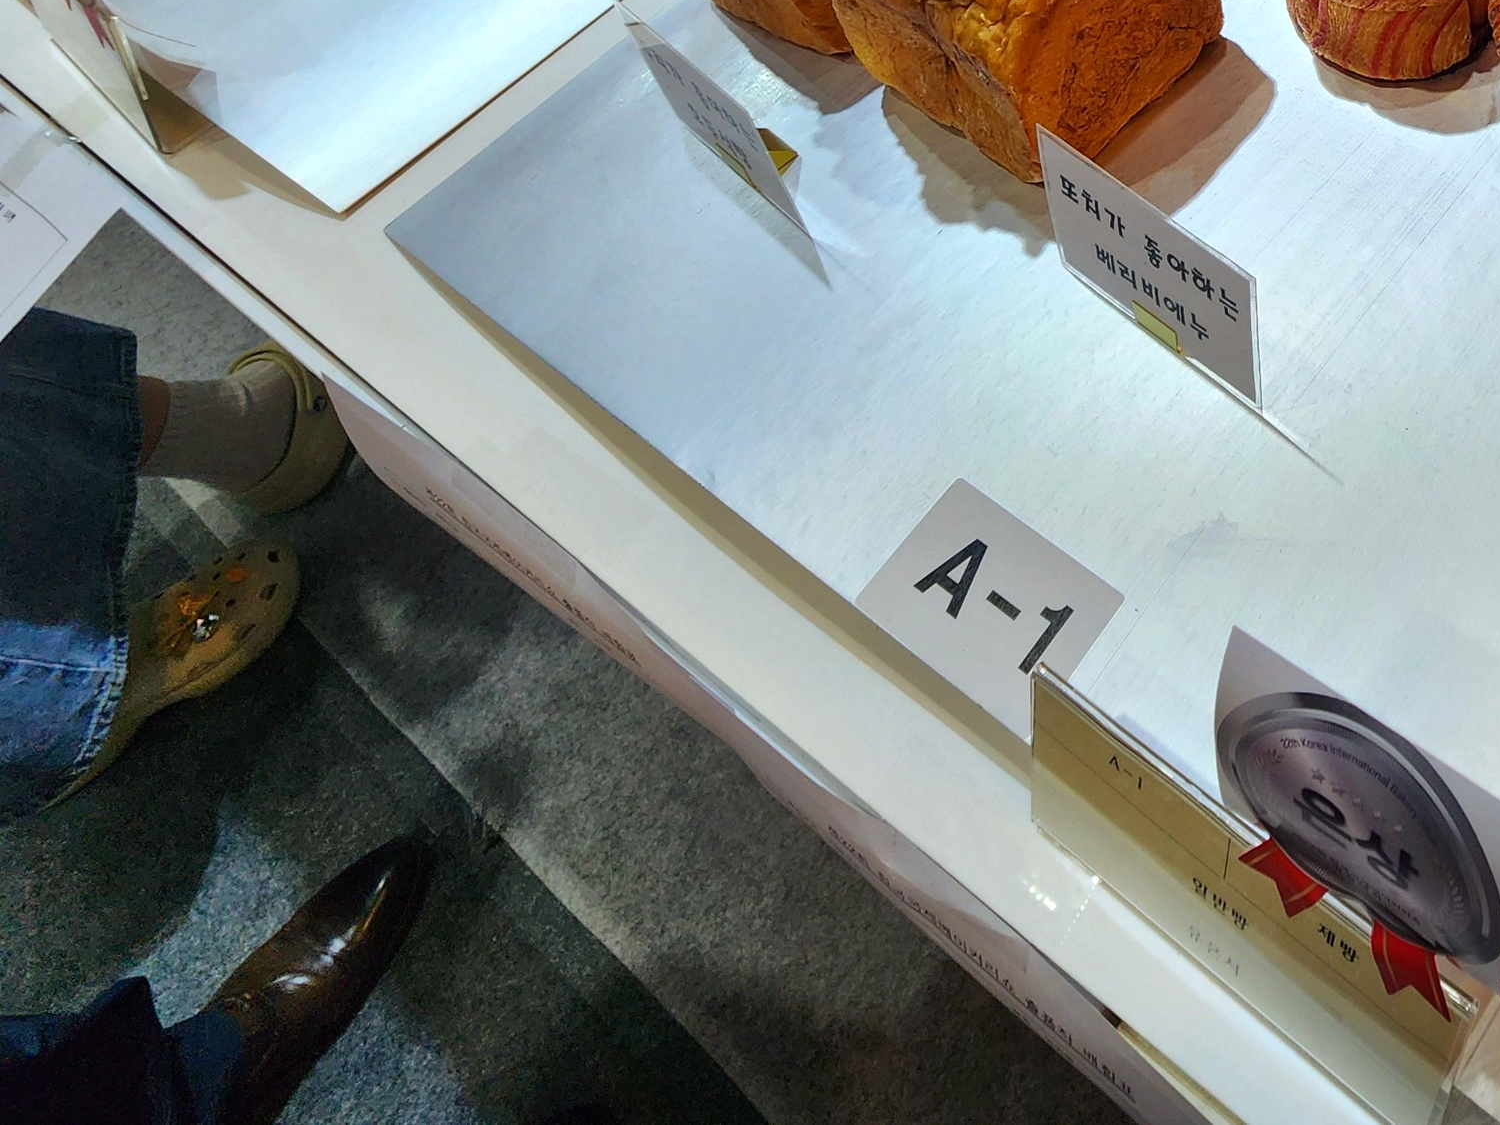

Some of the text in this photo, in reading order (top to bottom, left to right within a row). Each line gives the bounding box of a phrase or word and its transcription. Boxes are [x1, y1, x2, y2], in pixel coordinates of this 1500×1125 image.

[1060, 174, 1239, 322] 또치가 좋아하는
[1094, 243, 1209, 341] 베리비에누
[913, 538, 1074, 675] A-1
[1301, 737, 1328, 753] Korea
[1329, 743, 1392, 789] International
[1293, 786, 1420, 889] 은상
[1192, 877, 1249, 931] 일반빵
[1317, 923, 1359, 963] 제빵
